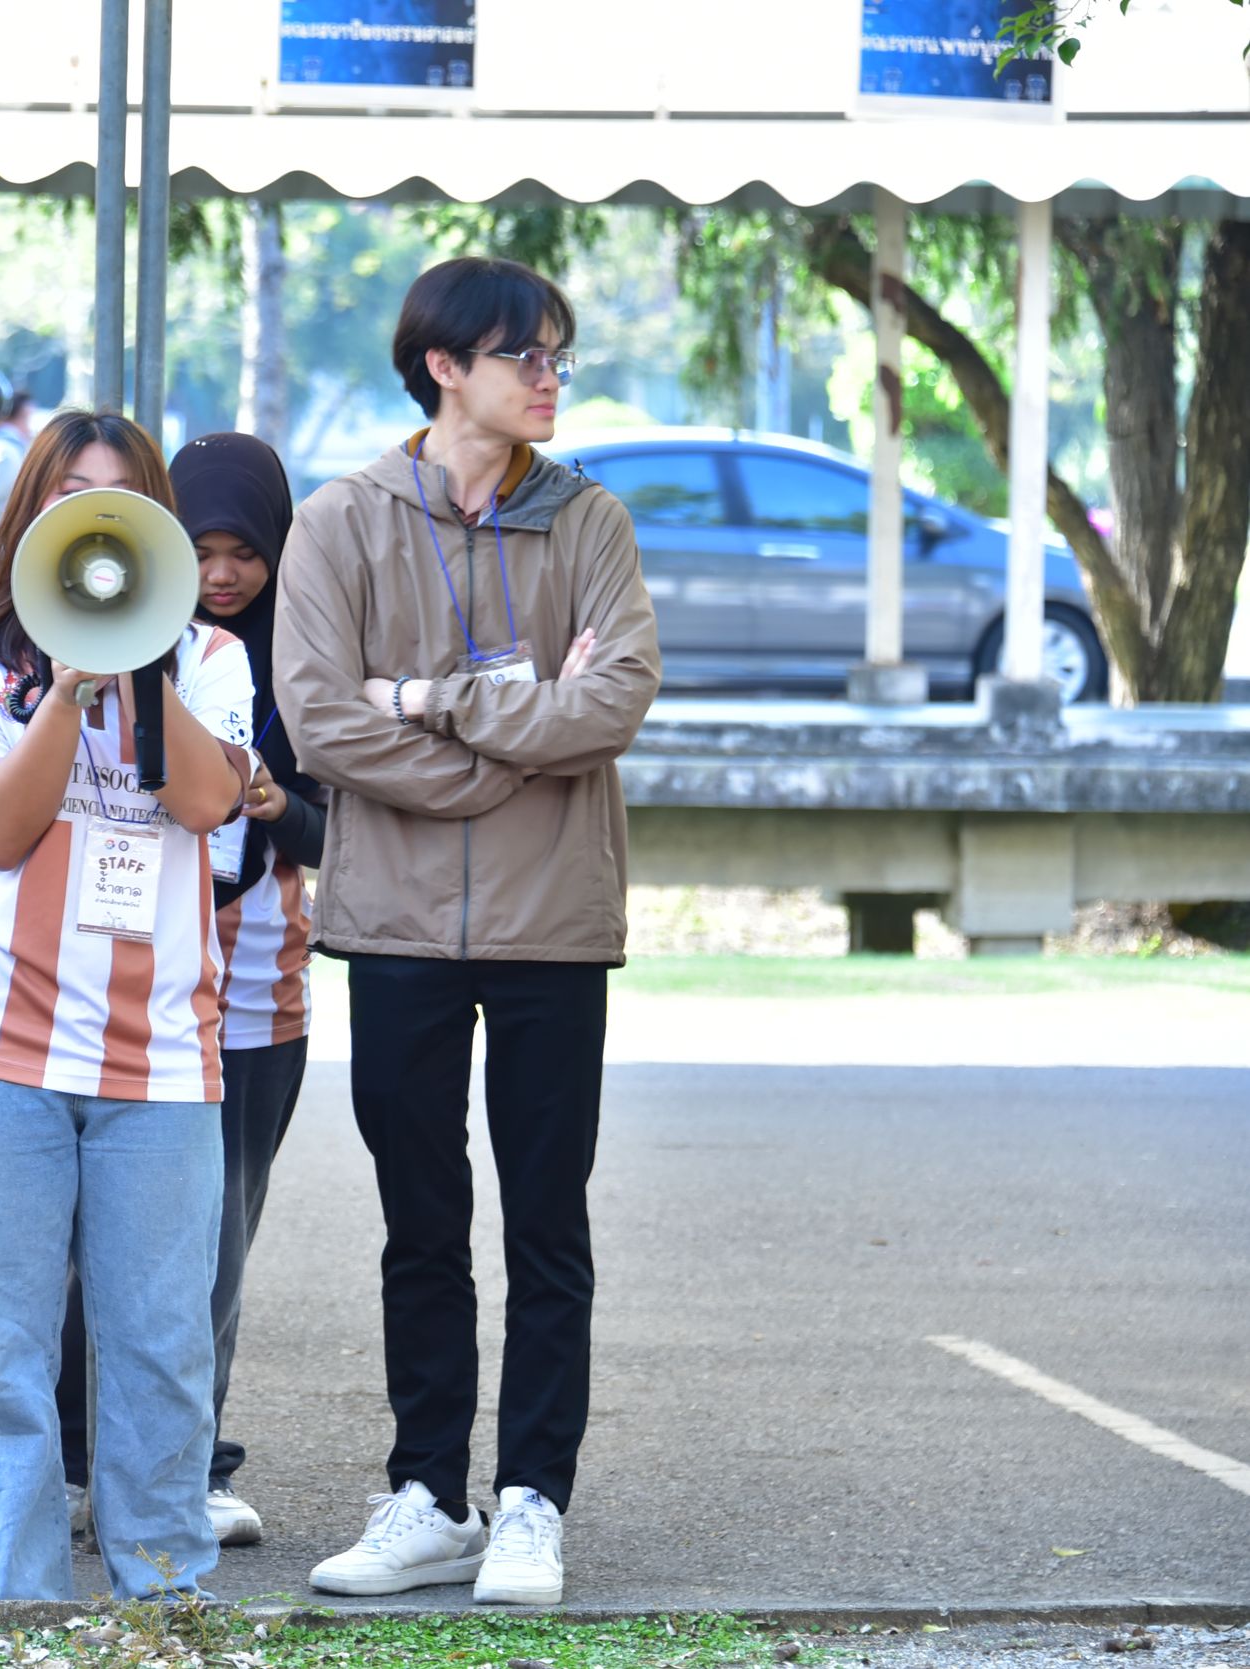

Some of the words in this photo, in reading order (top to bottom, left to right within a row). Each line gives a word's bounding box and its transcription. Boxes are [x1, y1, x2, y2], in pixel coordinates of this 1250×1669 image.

[98, 857, 146, 874] STAFF
[95, 871, 142, 897] น้ำตาล
